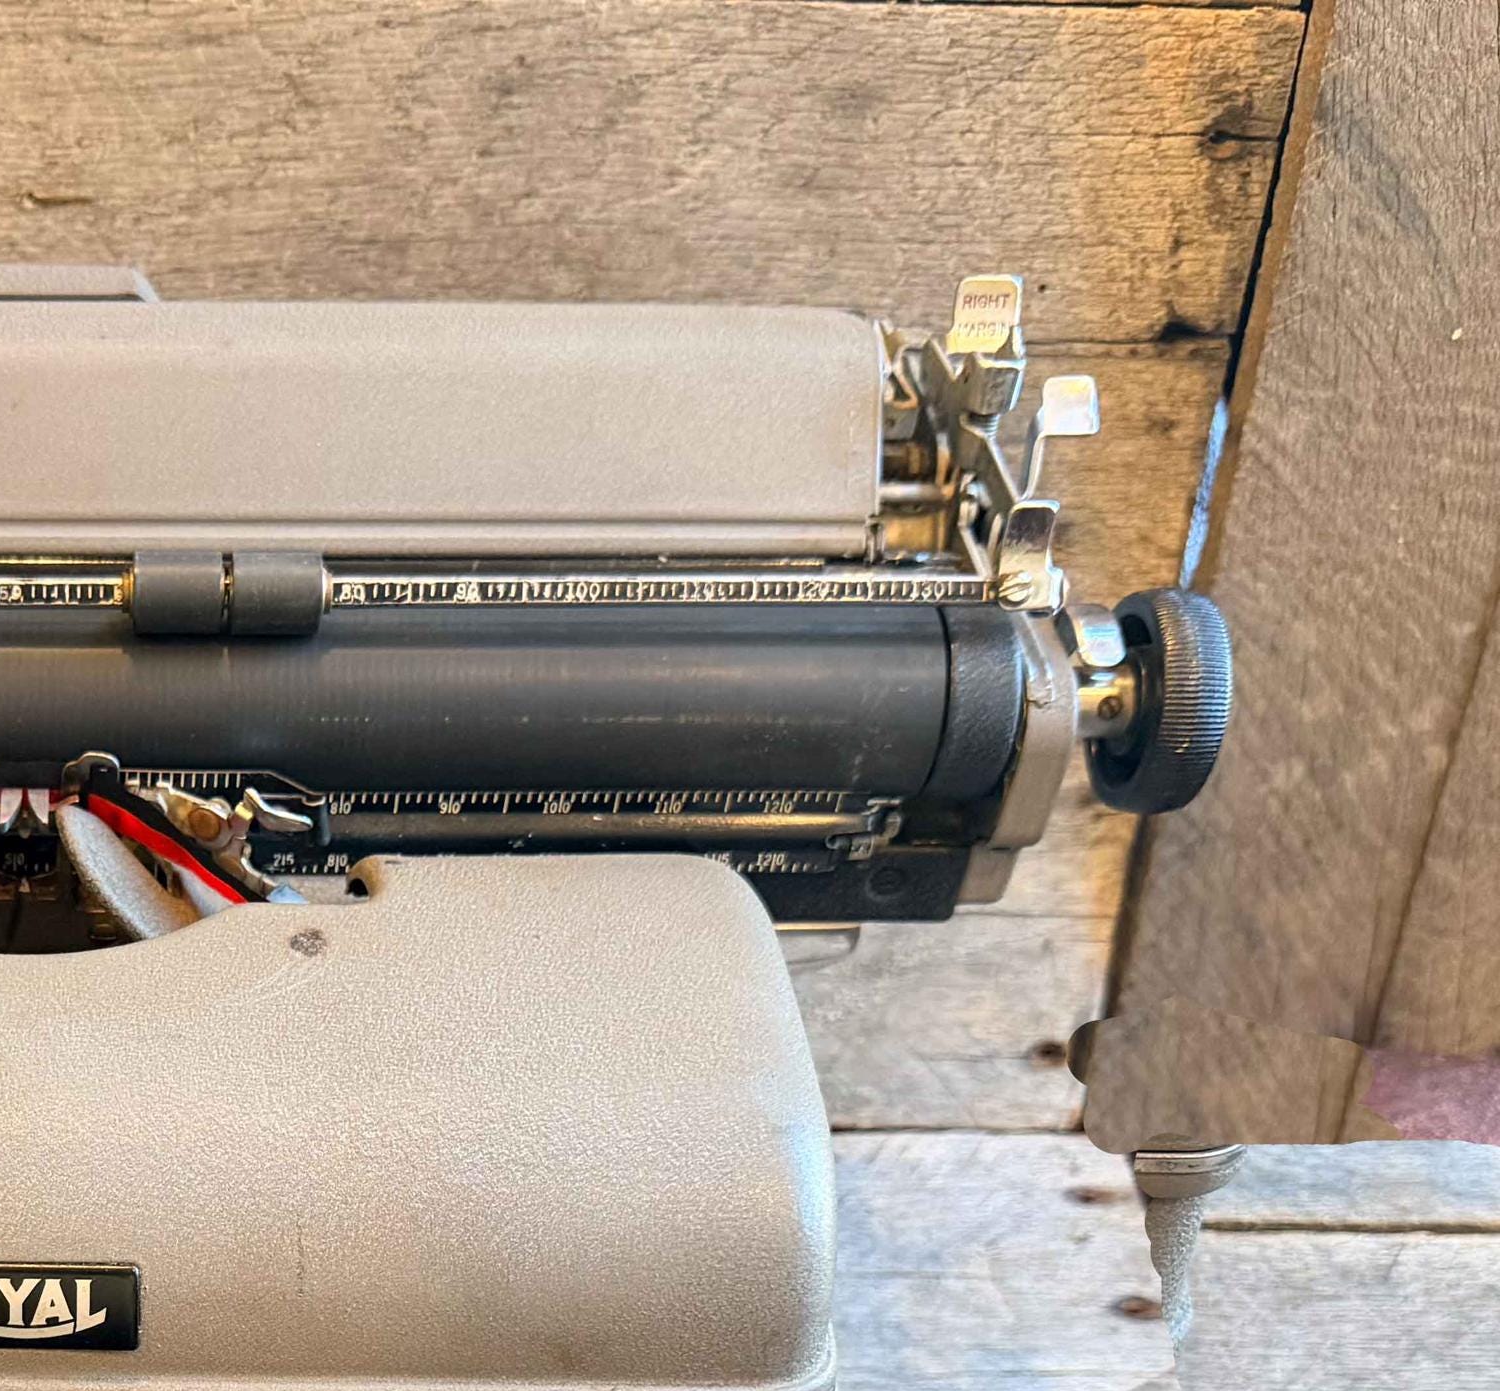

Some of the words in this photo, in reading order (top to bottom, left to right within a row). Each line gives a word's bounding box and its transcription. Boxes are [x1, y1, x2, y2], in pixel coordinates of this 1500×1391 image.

[963, 294, 1011, 309] RIGHT
[330, 801, 351, 815] 80
[439, 801, 461, 815] 90
[543, 801, 571, 815] 100
[654, 801, 681, 815] 110
[763, 801, 793, 814] 120
[757, 853, 784, 866] 120
